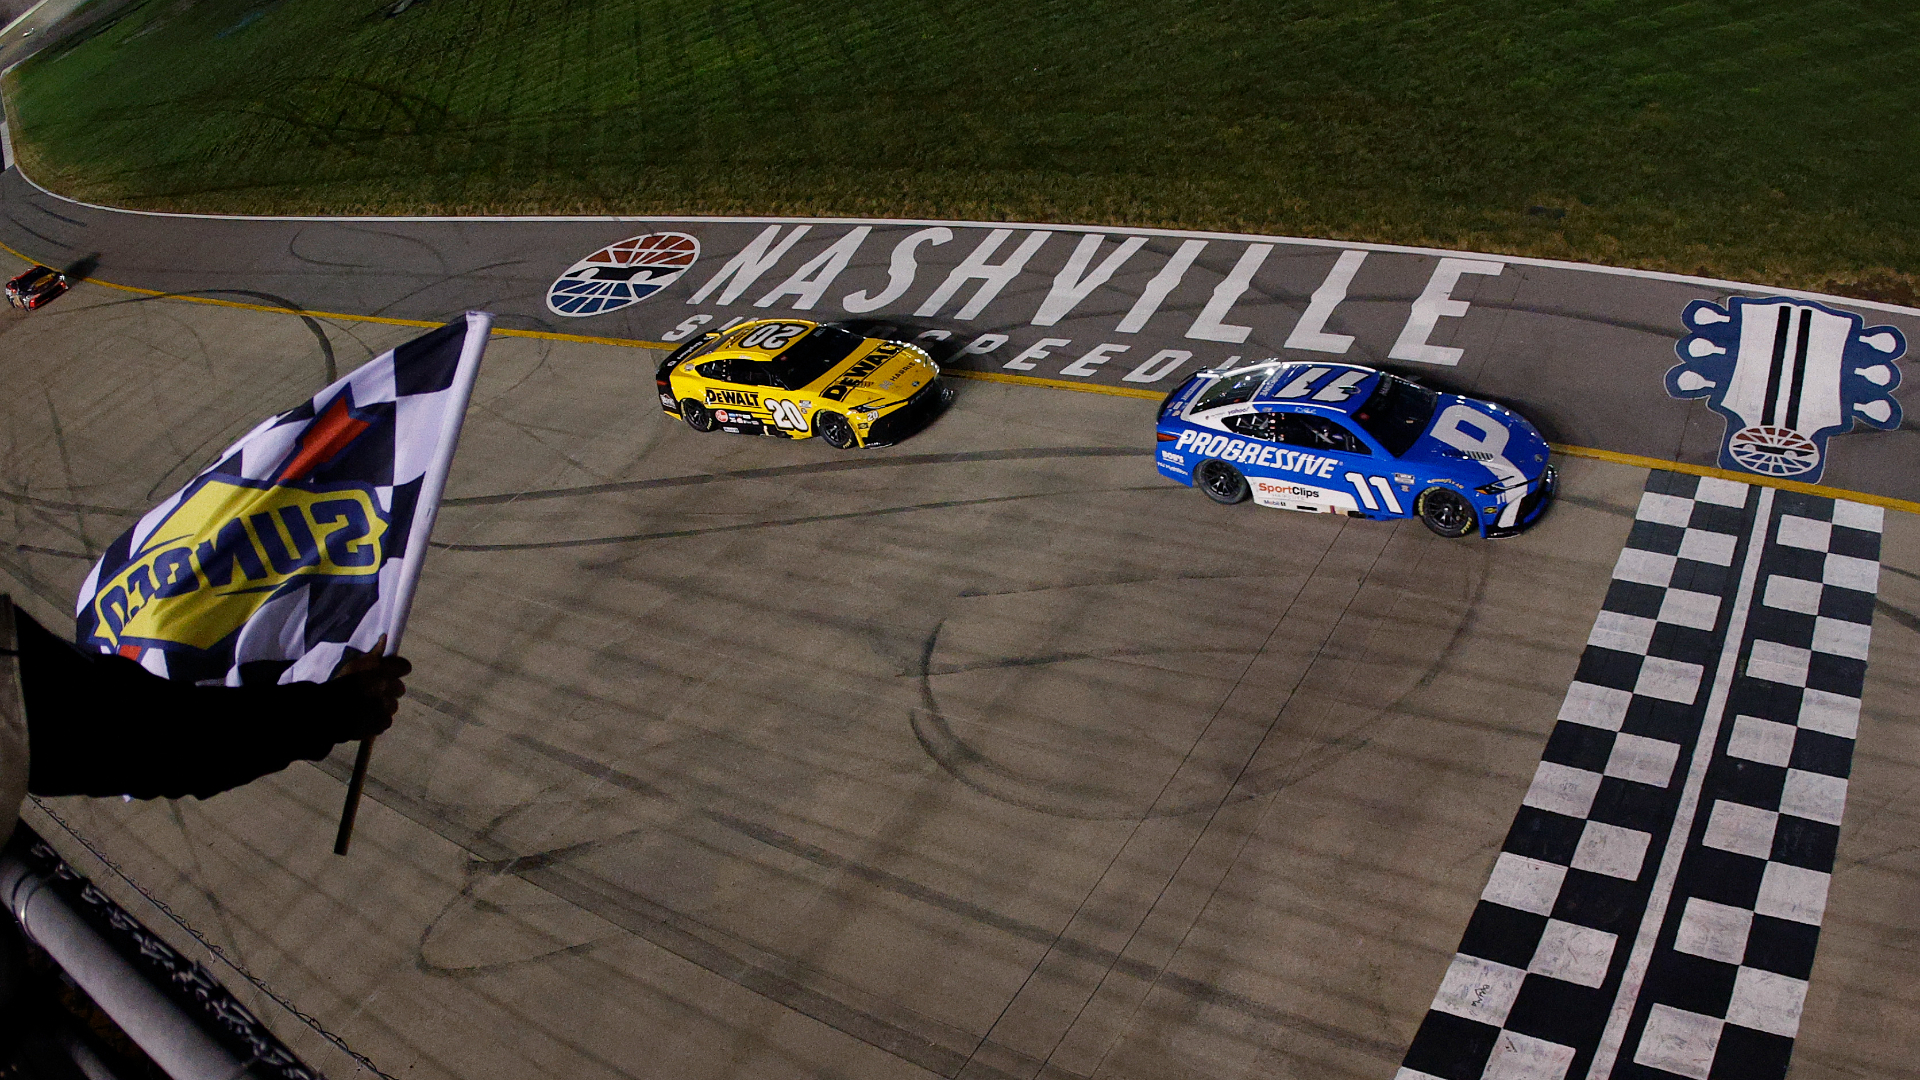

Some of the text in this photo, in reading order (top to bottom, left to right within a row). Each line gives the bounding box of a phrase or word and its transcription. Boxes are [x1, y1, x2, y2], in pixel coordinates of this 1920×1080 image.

[686, 225, 1505, 366] NASHVILLE
[740, 323, 808, 349] 20
[890, 362, 916, 382] HARRIS
[1273, 367, 1369, 401] 11
[764, 398, 809, 432] 20
[867, 411, 878, 421] 20
[1175, 429, 1339, 479] PROGRESSIVE
[1259, 483, 1319, 498] SportClips
[1344, 472, 1403, 514] 11
[1496, 493, 1506, 504] 11
